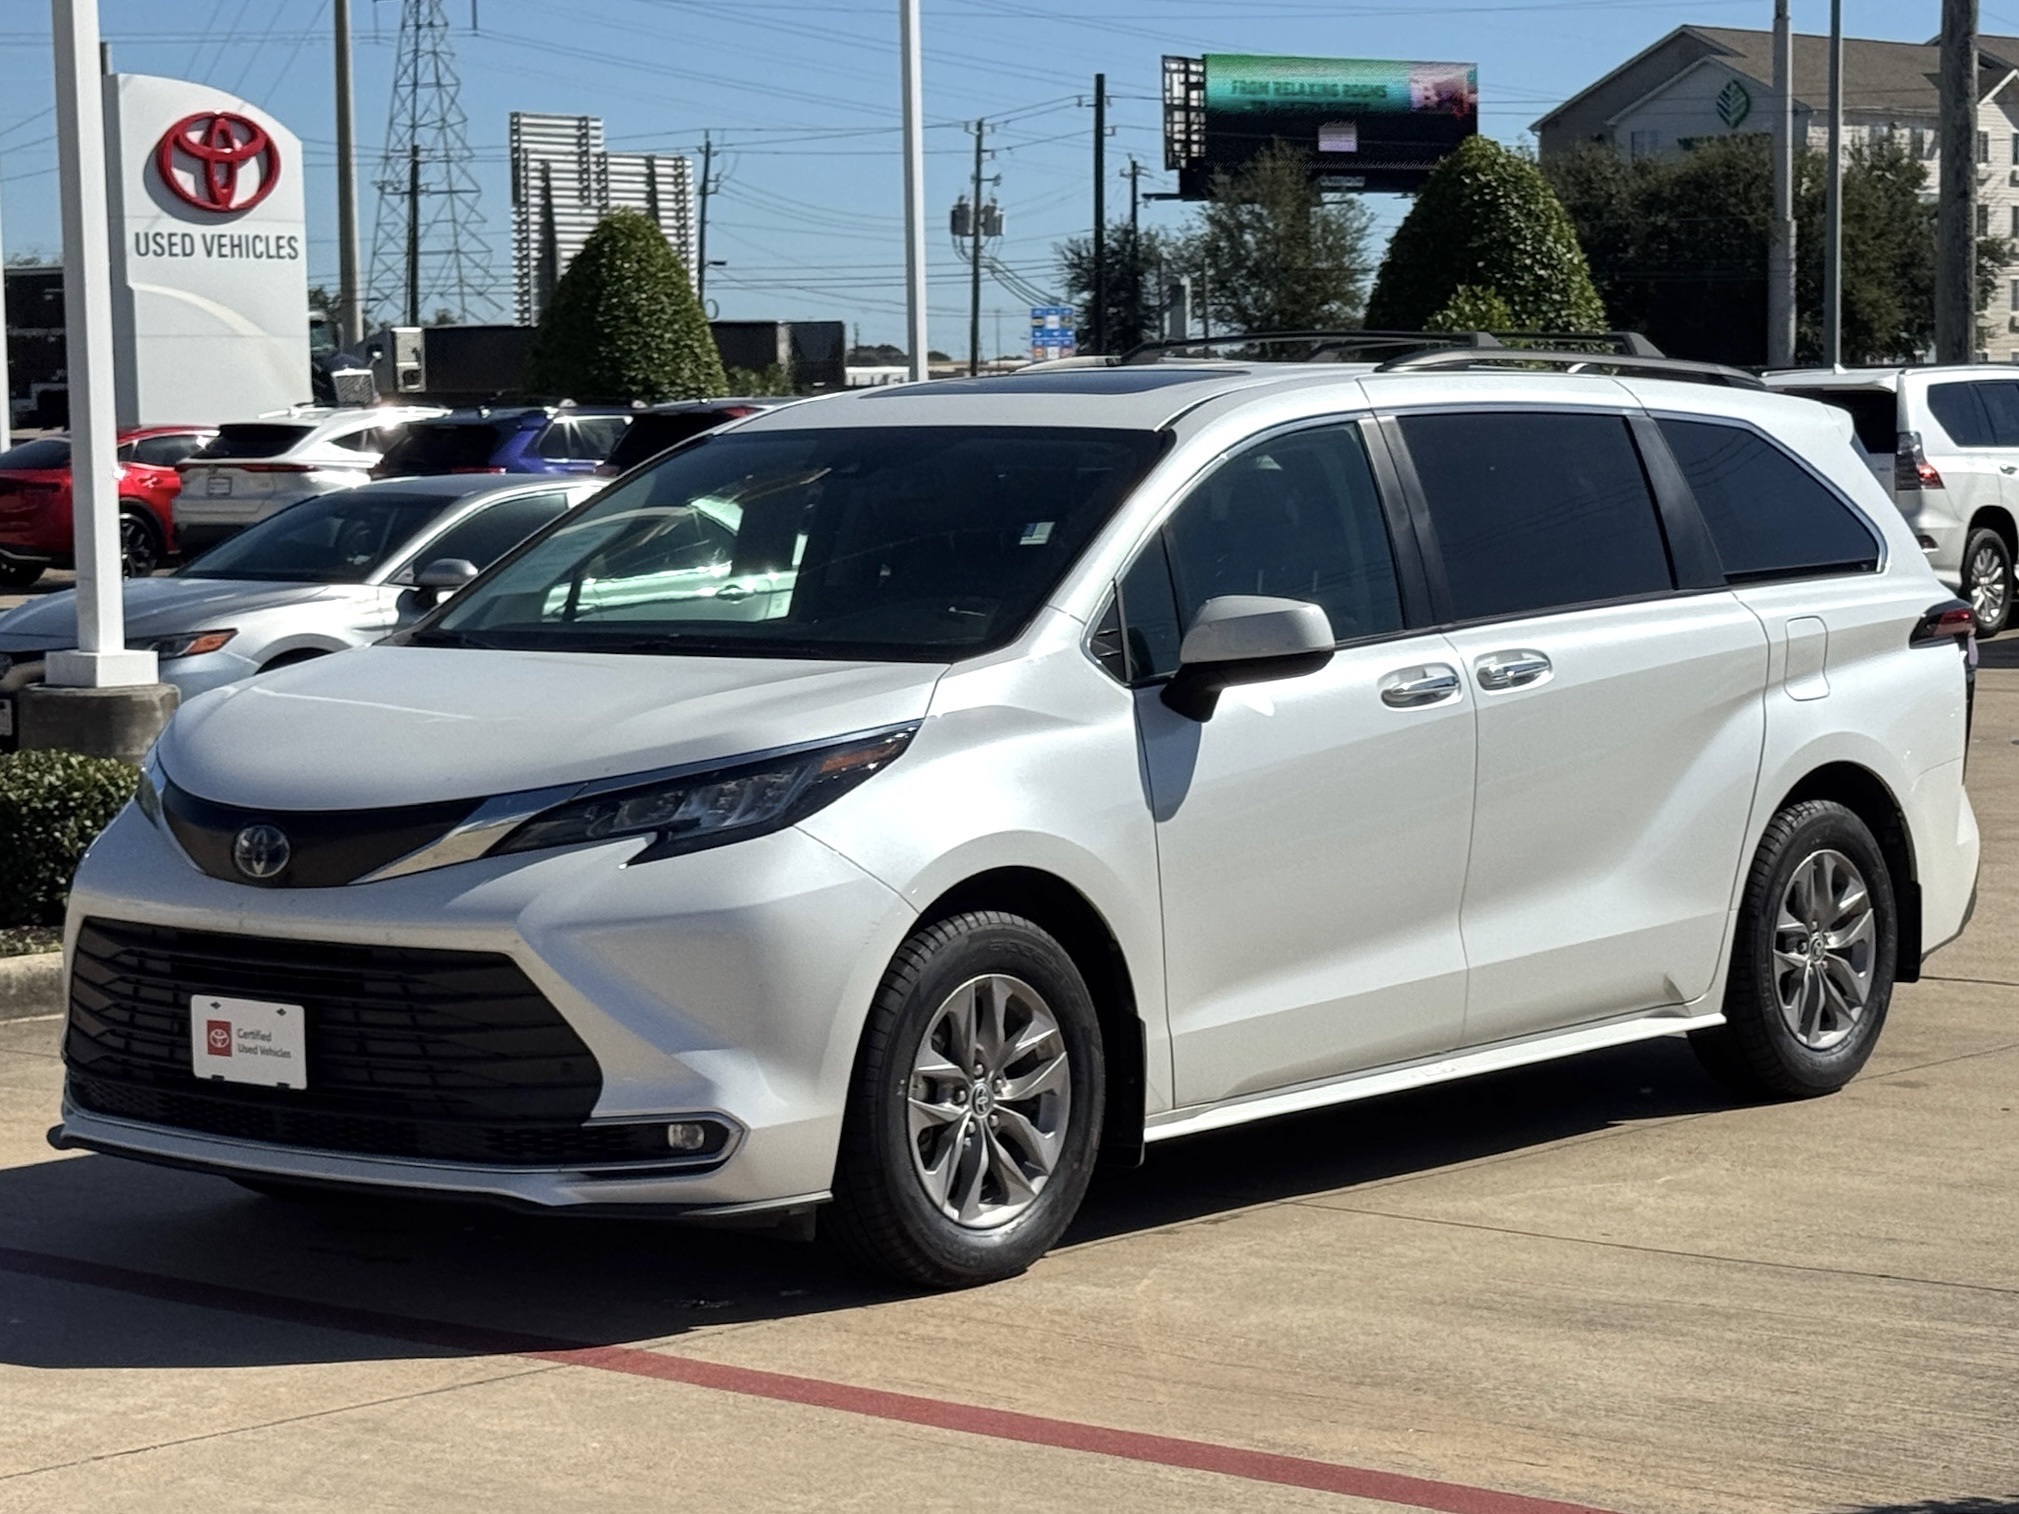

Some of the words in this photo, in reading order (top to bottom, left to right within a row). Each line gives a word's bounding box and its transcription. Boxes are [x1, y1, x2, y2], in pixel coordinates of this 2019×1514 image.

[134, 232, 195, 258] USED
[201, 233, 299, 260] VEHICLES
[237, 1028, 272, 1043] Certified
[238, 1043, 259, 1055] Used
[260, 1046, 292, 1059] Vehicles
